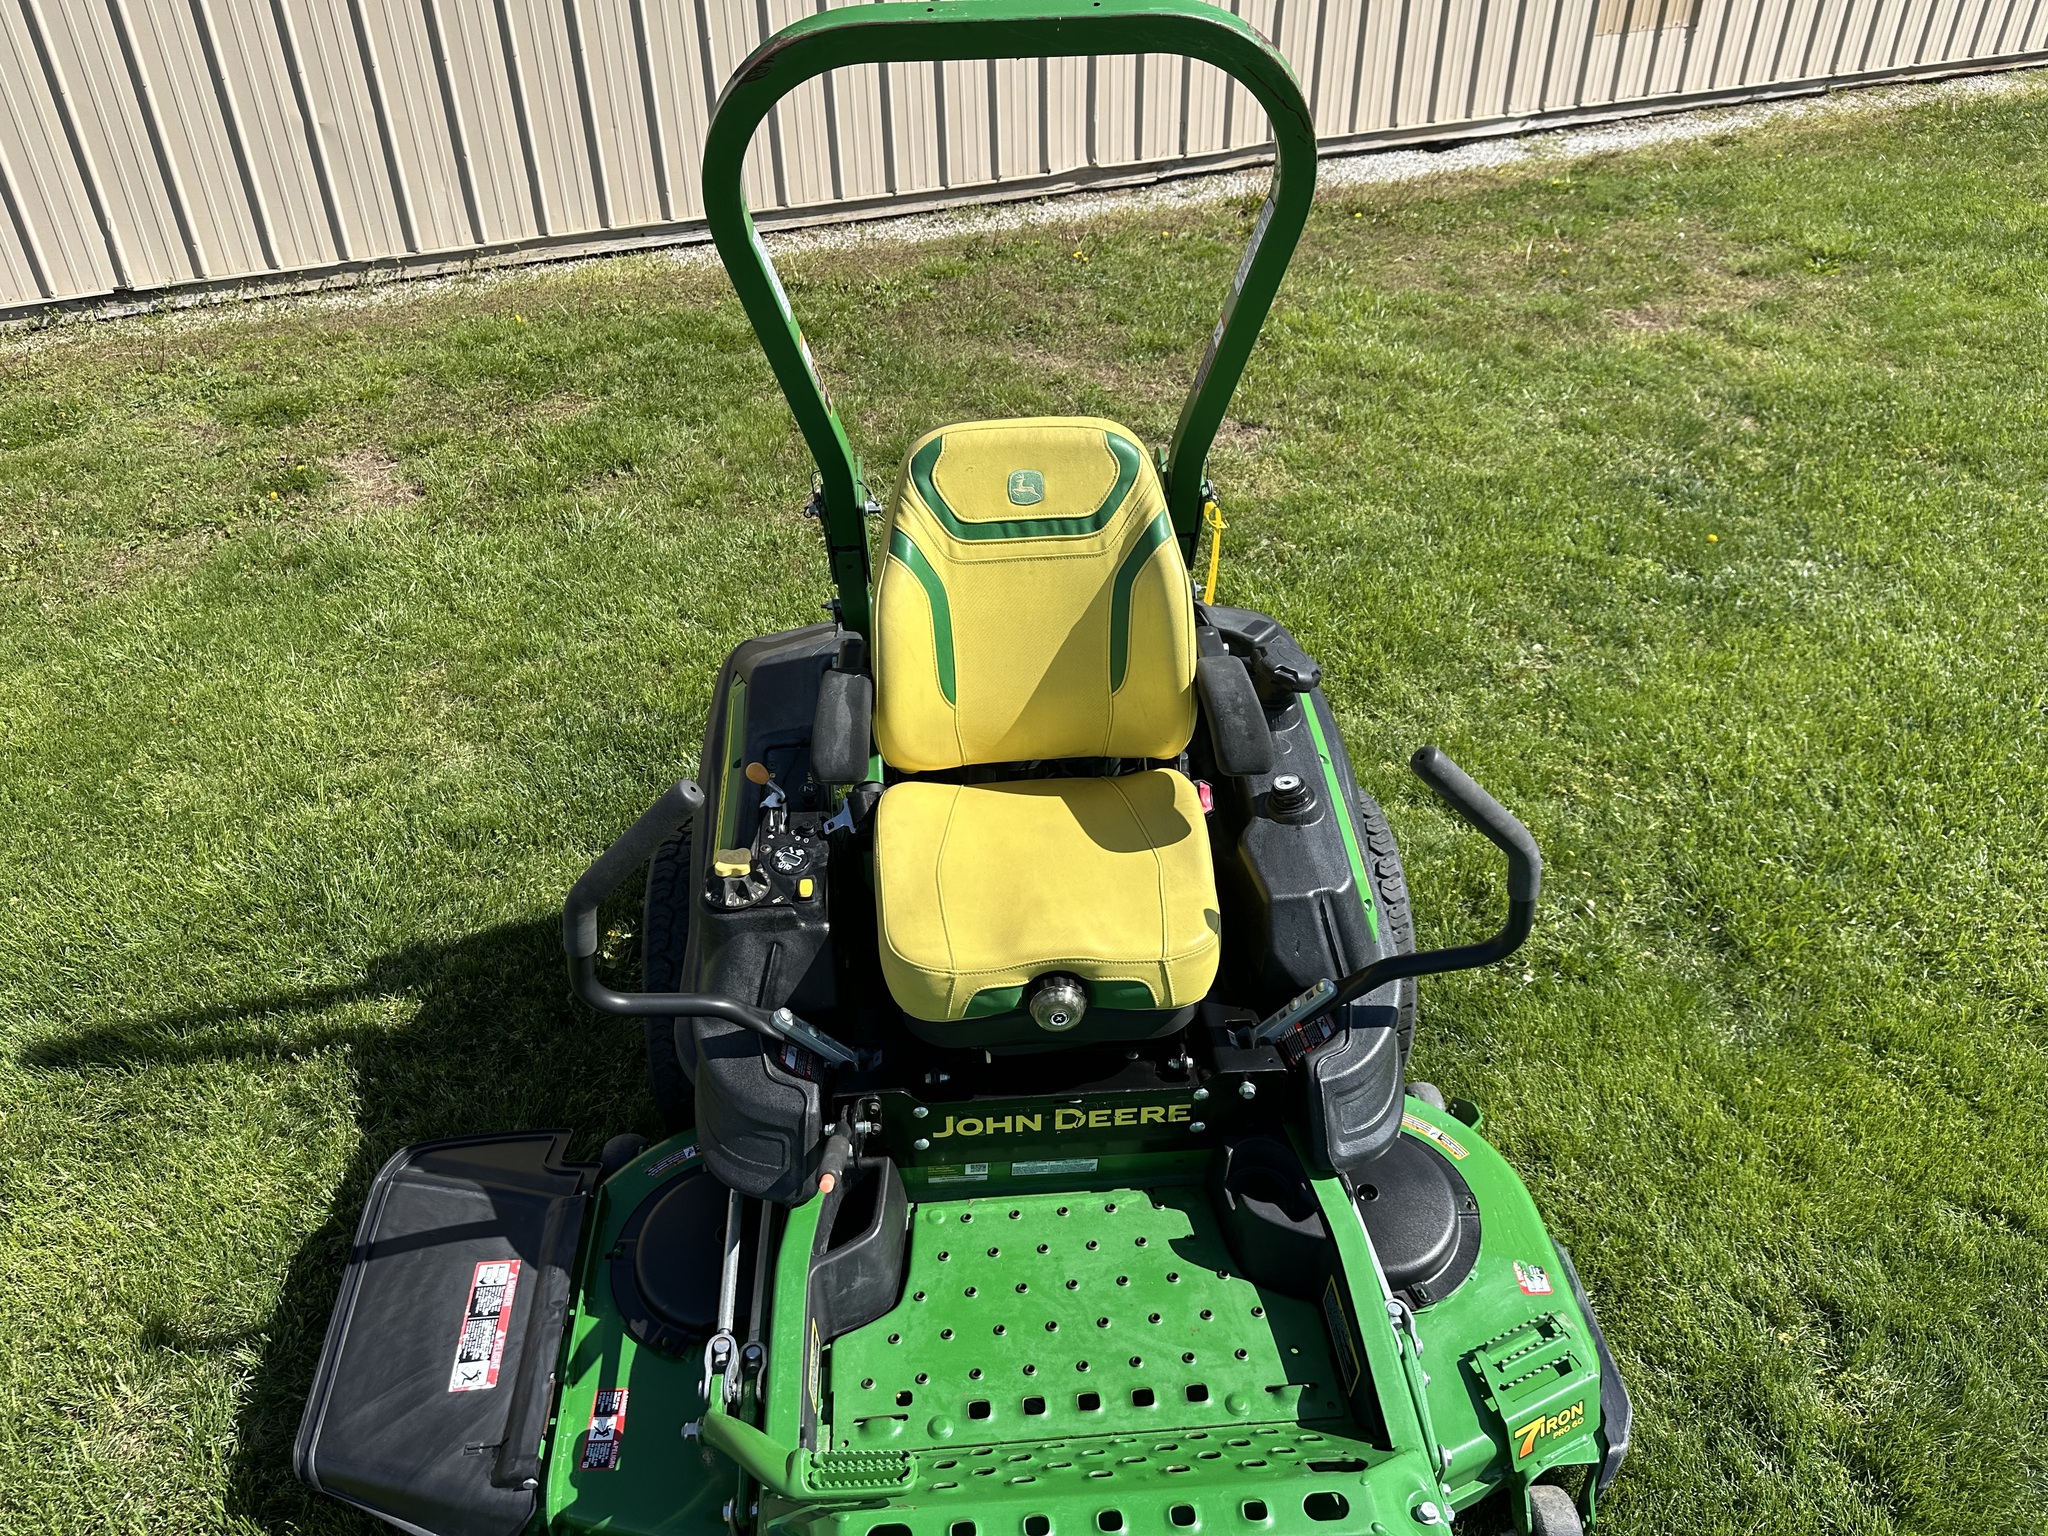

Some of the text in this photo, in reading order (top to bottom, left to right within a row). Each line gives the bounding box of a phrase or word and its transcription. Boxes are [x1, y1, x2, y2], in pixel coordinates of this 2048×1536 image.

[932, 1103, 1192, 1138] JOHN DEERE
[503, 1280, 515, 1307] DANGER
[490, 1340, 505, 1370] PELIGRO
[1553, 1416, 1584, 1440] PRO 60
[608, 1445, 619, 1469] PELIGRO
